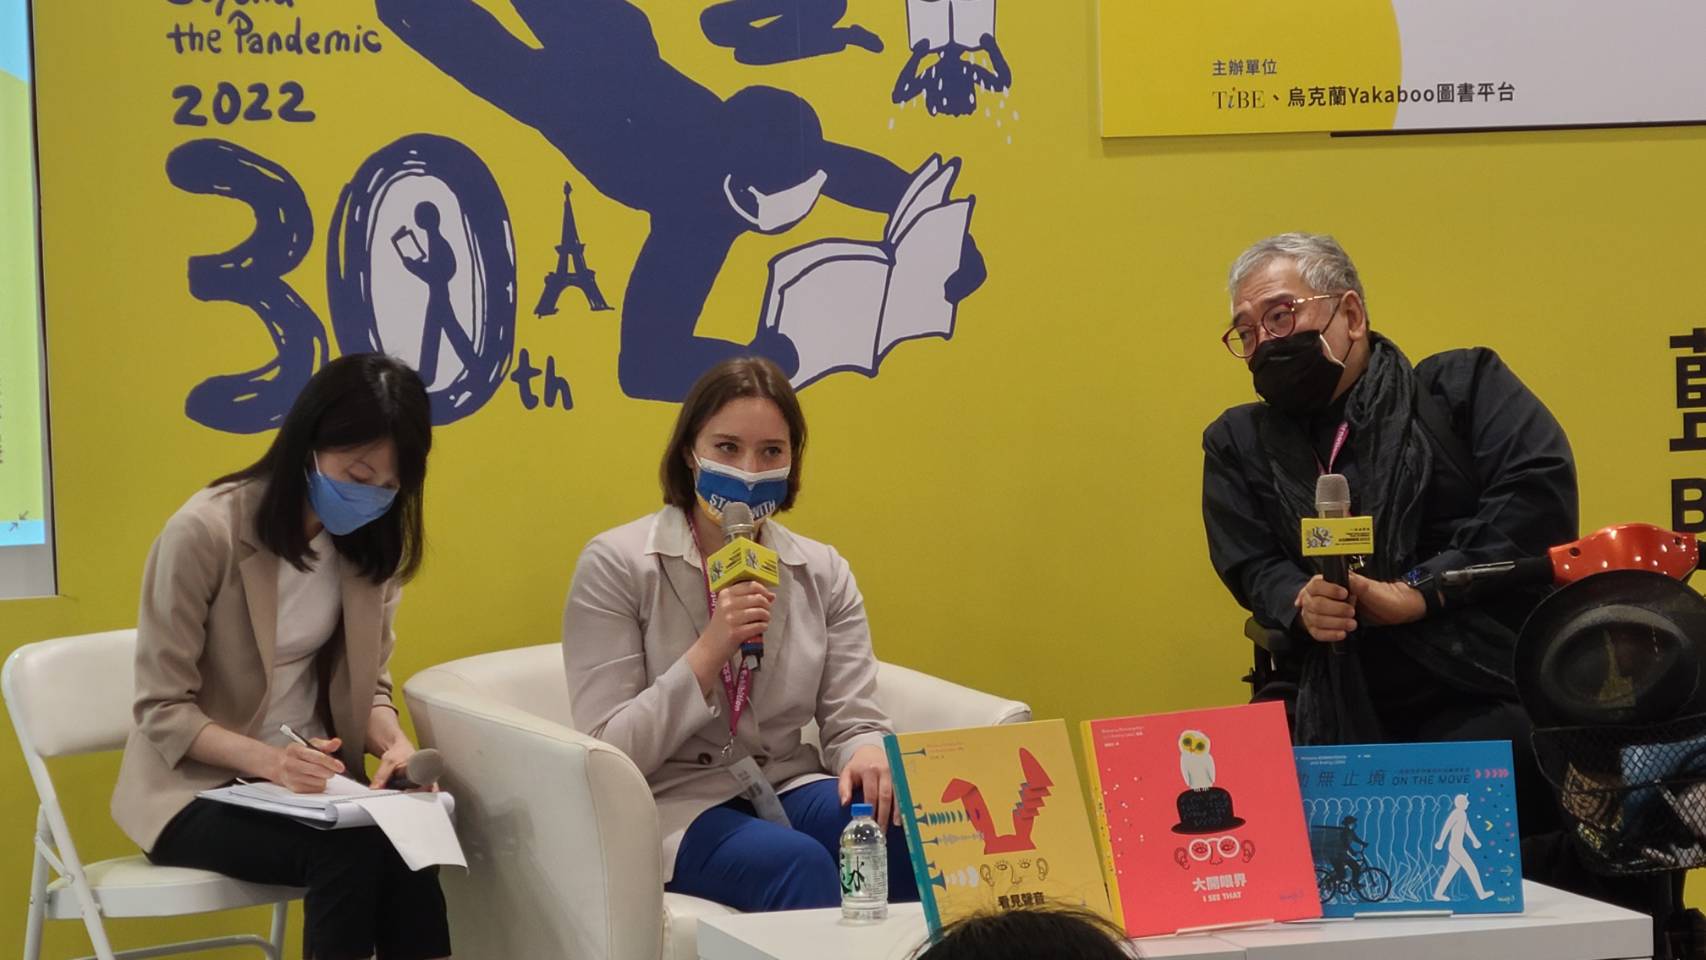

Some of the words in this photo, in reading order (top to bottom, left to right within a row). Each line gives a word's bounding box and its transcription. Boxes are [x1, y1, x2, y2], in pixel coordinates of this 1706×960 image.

[166, 22, 221, 54] the
[228, 10, 382, 54] Pandemic
[1212, 59, 1277, 76] 主辦單位
[172, 81, 316, 126] 2022
[1391, 775, 1409, 787] ON
[1413, 775, 1434, 785] THE
[1438, 773, 1472, 785] MOVE
[1192, 872, 1247, 892] 大開眼界
[997, 891, 1046, 909] 看見聲音
[1208, 893, 1221, 903] SEE
[1223, 891, 1242, 901] THAT
